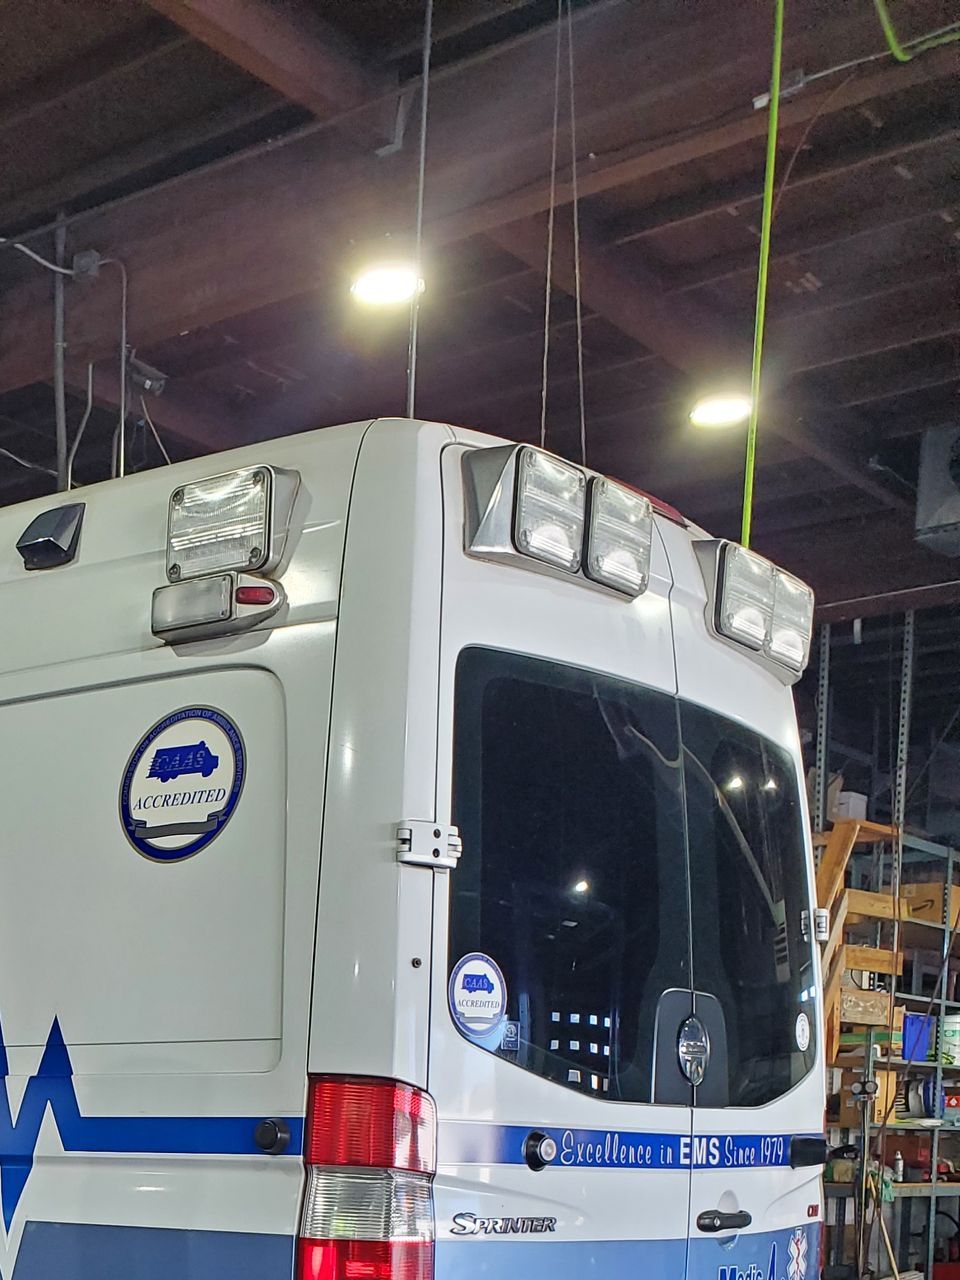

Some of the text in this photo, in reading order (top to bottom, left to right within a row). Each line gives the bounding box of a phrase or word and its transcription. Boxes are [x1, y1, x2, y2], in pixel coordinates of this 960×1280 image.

[133, 788, 226, 810] ACCREDITED
[465, 977, 488, 988] CAAS
[458, 999, 500, 1009] ACCREDITED
[560, 1130, 783, 1166] Excellence in EMS Since 1979
